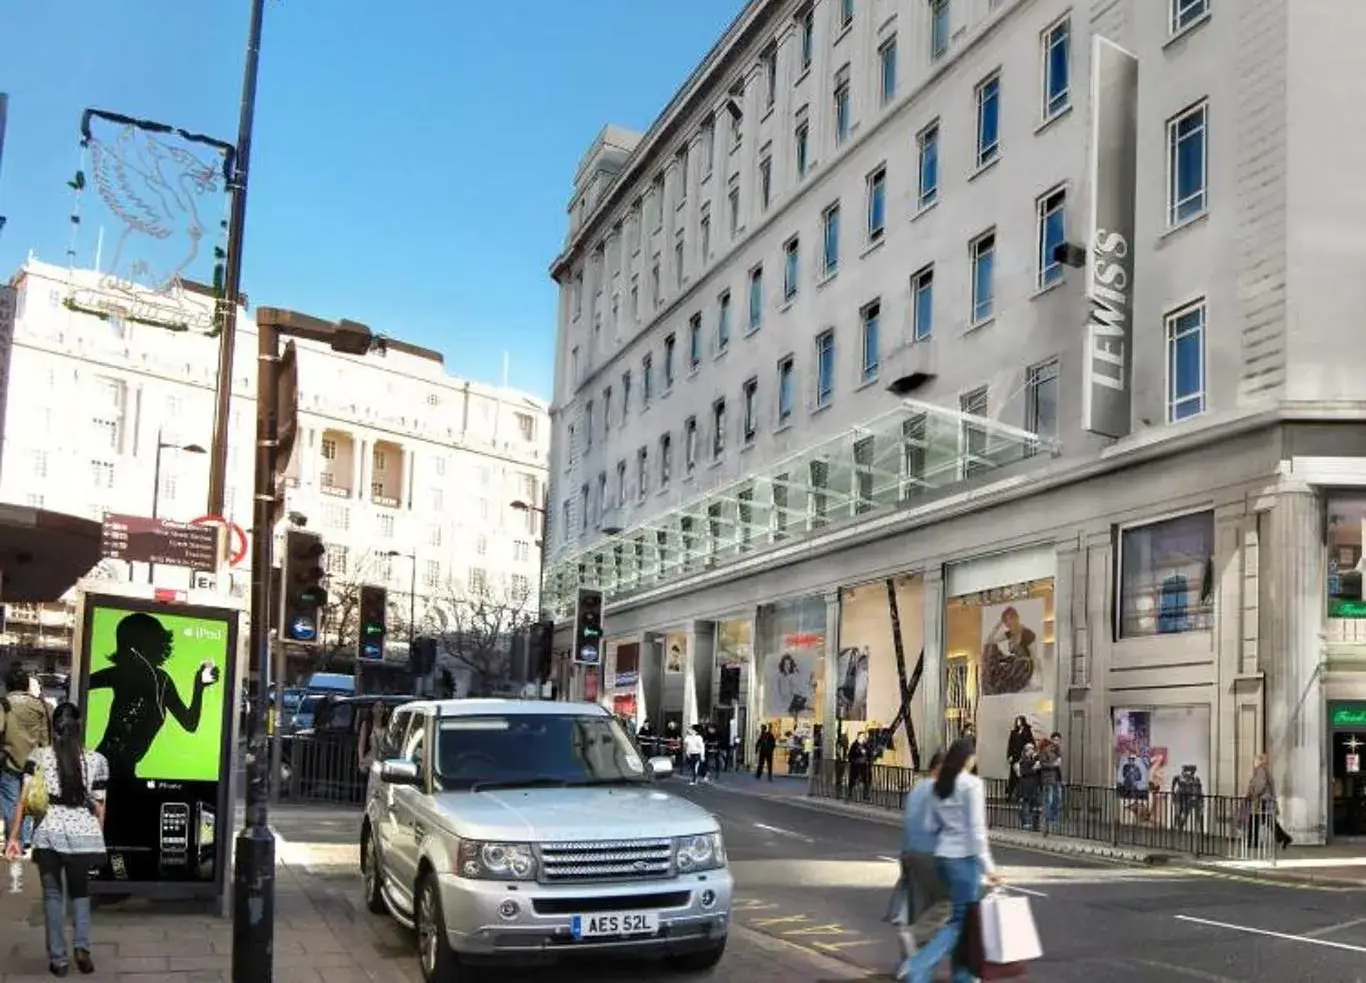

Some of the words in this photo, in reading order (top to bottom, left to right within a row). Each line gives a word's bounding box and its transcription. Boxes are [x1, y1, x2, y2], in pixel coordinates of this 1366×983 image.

[196, 627, 222, 640] iPod
[588, 917, 619, 932] AES
[622, 915, 652, 931] 52L
